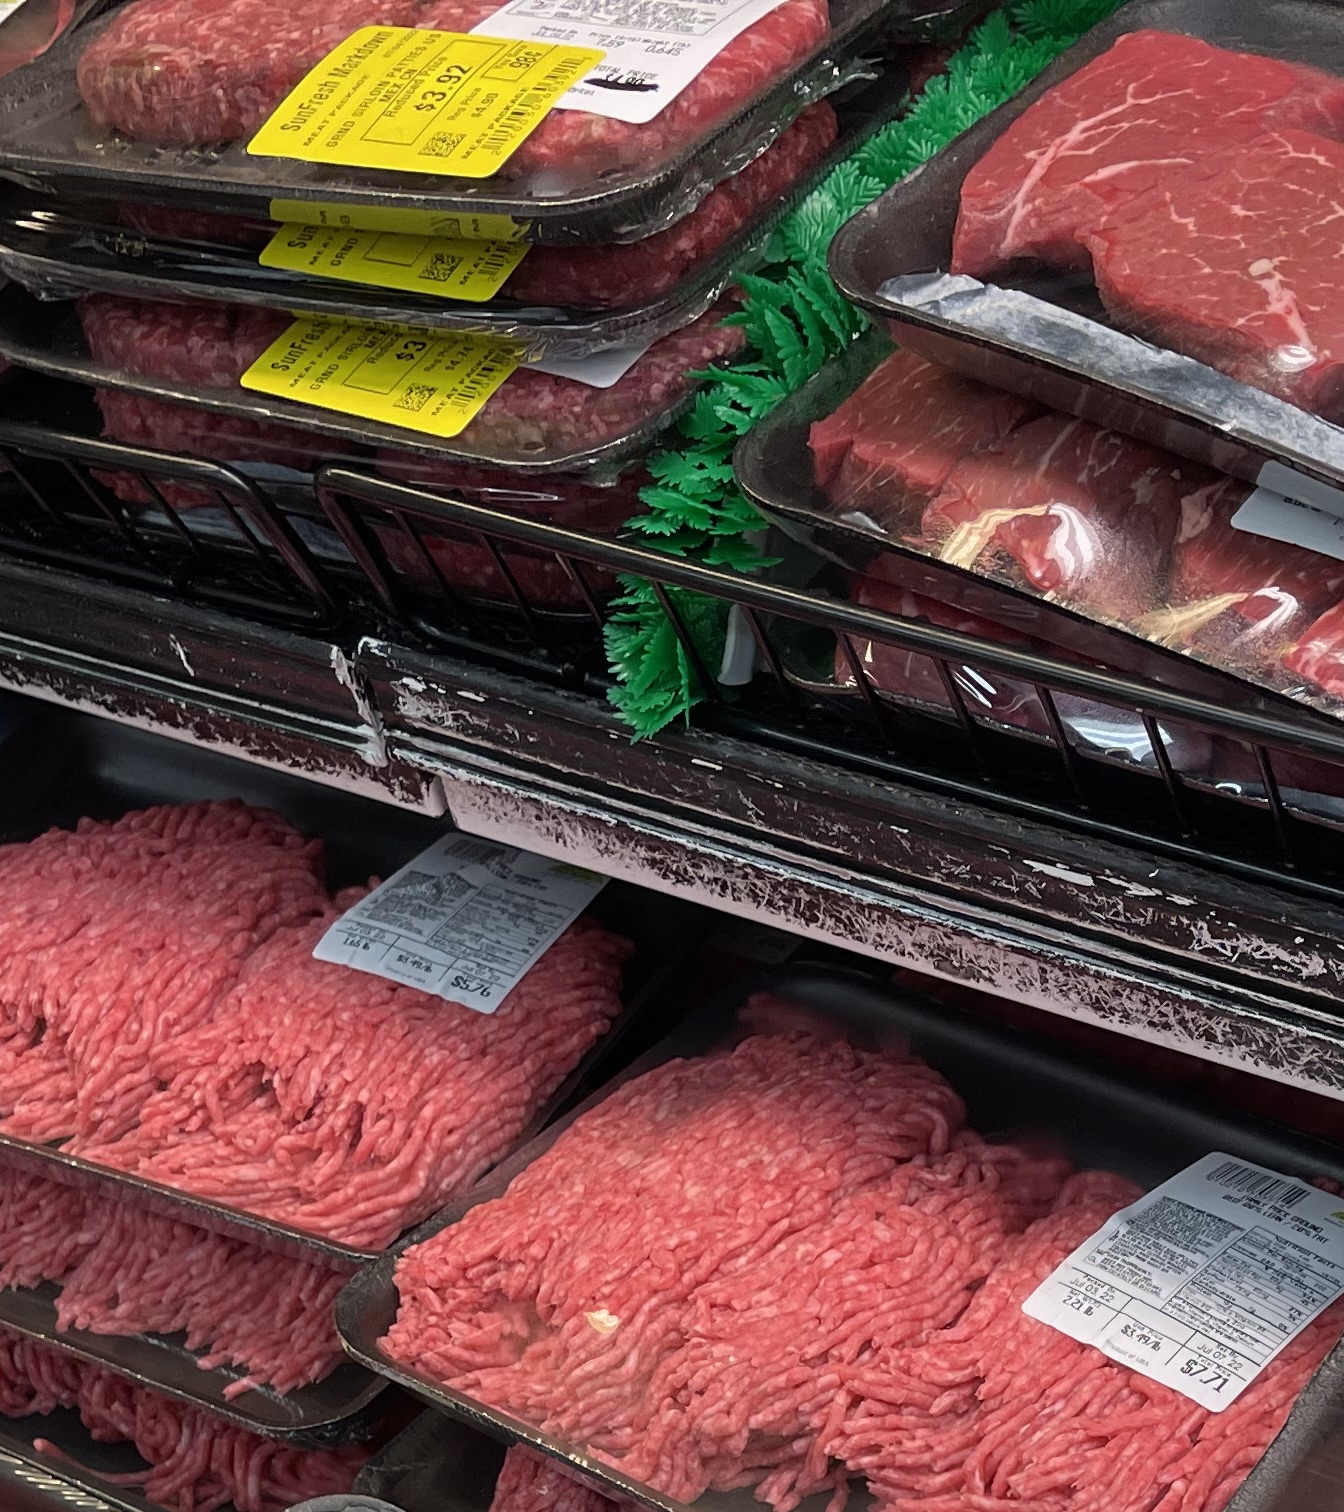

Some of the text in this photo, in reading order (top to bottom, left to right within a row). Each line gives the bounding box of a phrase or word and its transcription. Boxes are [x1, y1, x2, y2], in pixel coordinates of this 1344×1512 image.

[279, 30, 395, 133] SunFresh Markdown
[325, 120, 356, 148] GRND
[355, 76, 389, 118] SIRLOIN
[386, 45, 428, 78] PATTIES
[378, 82, 402, 103] MEX
[383, 56, 448, 119] Reduced Price
[413, 64, 474, 113] $3.92
[303, 74, 369, 146] MEAT PACKAGE
[446, 102, 465, 122] Reg
[470, 92, 498, 119] $4.90
[460, 87, 529, 160] MEAT PACKAGE
[329, 237, 359, 267] GRND
[458, 255, 486, 285] MEAT
[289, 359, 316, 388] MEAT
[309, 363, 340, 391] GRND
[430, 387, 458, 416] MEAT
[451, 975, 491, 998] $5.76
[1121, 1324, 1162, 1352] $3.49/lb
[1180, 1358, 1230, 1394] $7.71
